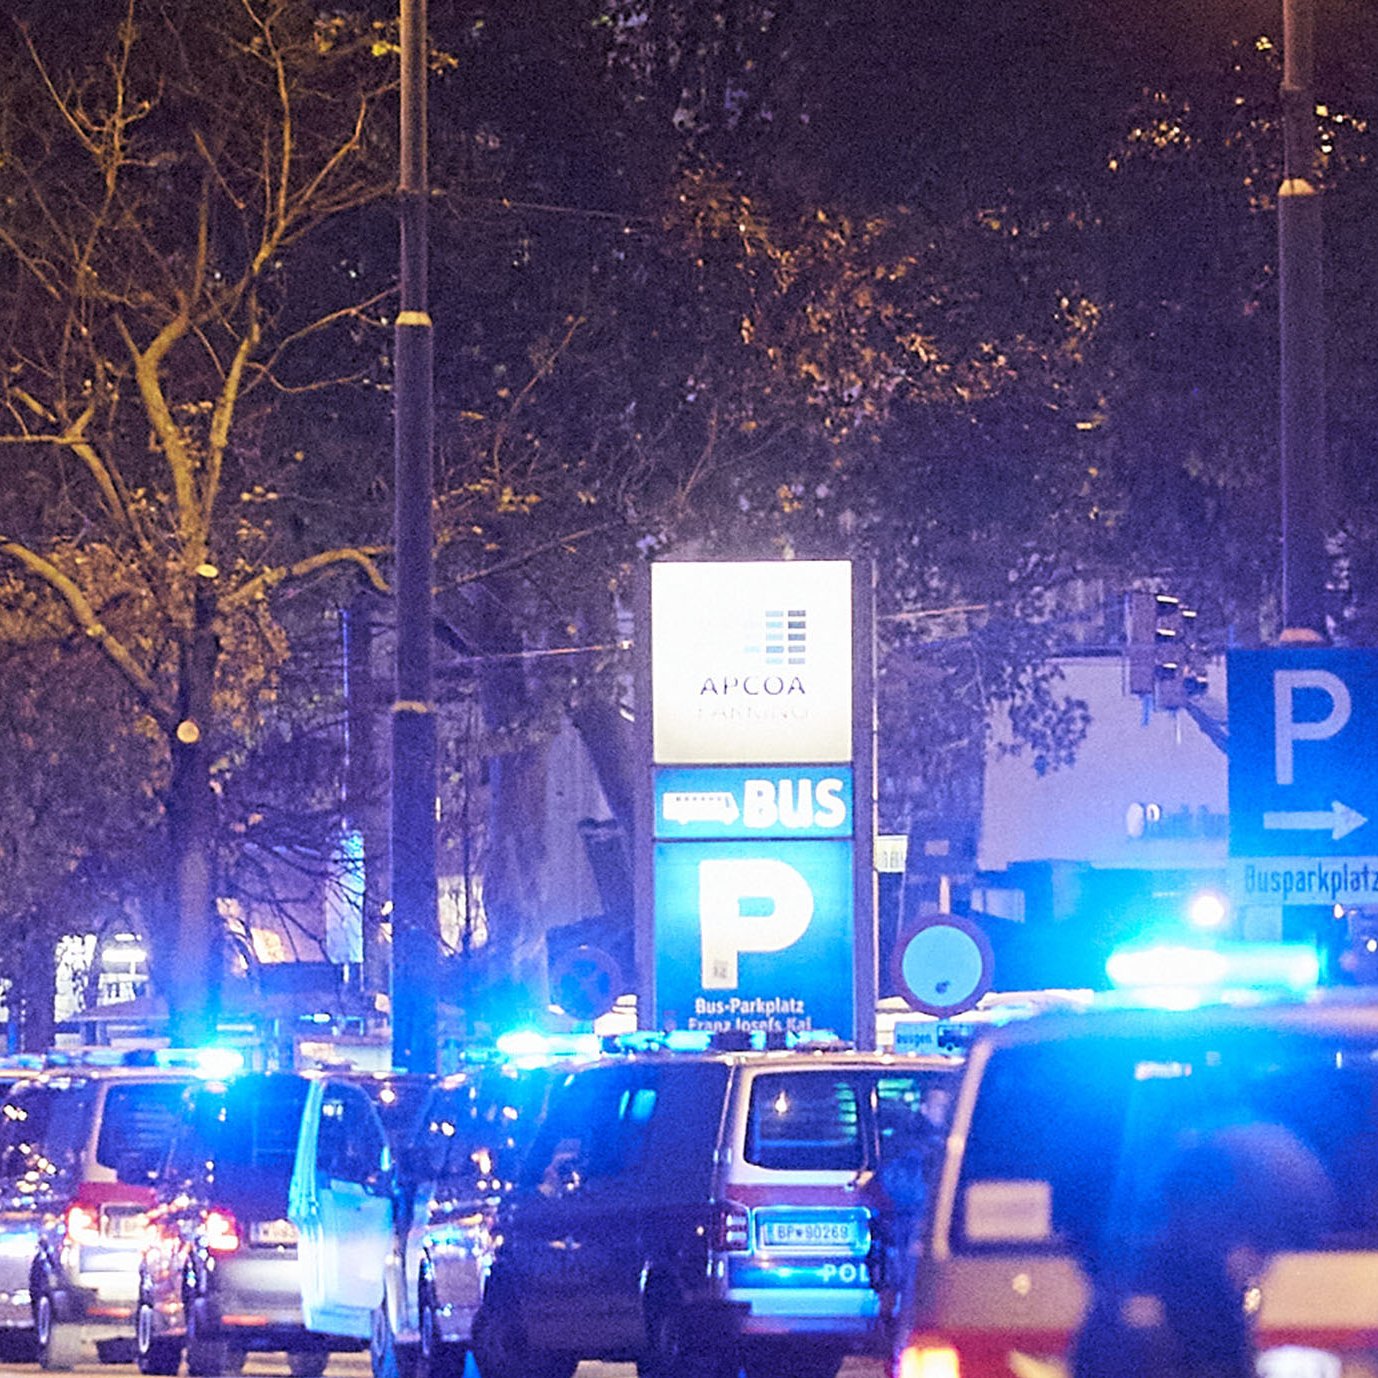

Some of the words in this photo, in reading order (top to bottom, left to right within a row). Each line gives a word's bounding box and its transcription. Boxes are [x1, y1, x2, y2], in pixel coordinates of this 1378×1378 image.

[700, 676, 806, 695] APCOA
[1274, 668, 1352, 785] P
[743, 778, 846, 829] BUS
[698, 859, 814, 990] P
[695, 996, 805, 1018] Bus-Parkplatz
